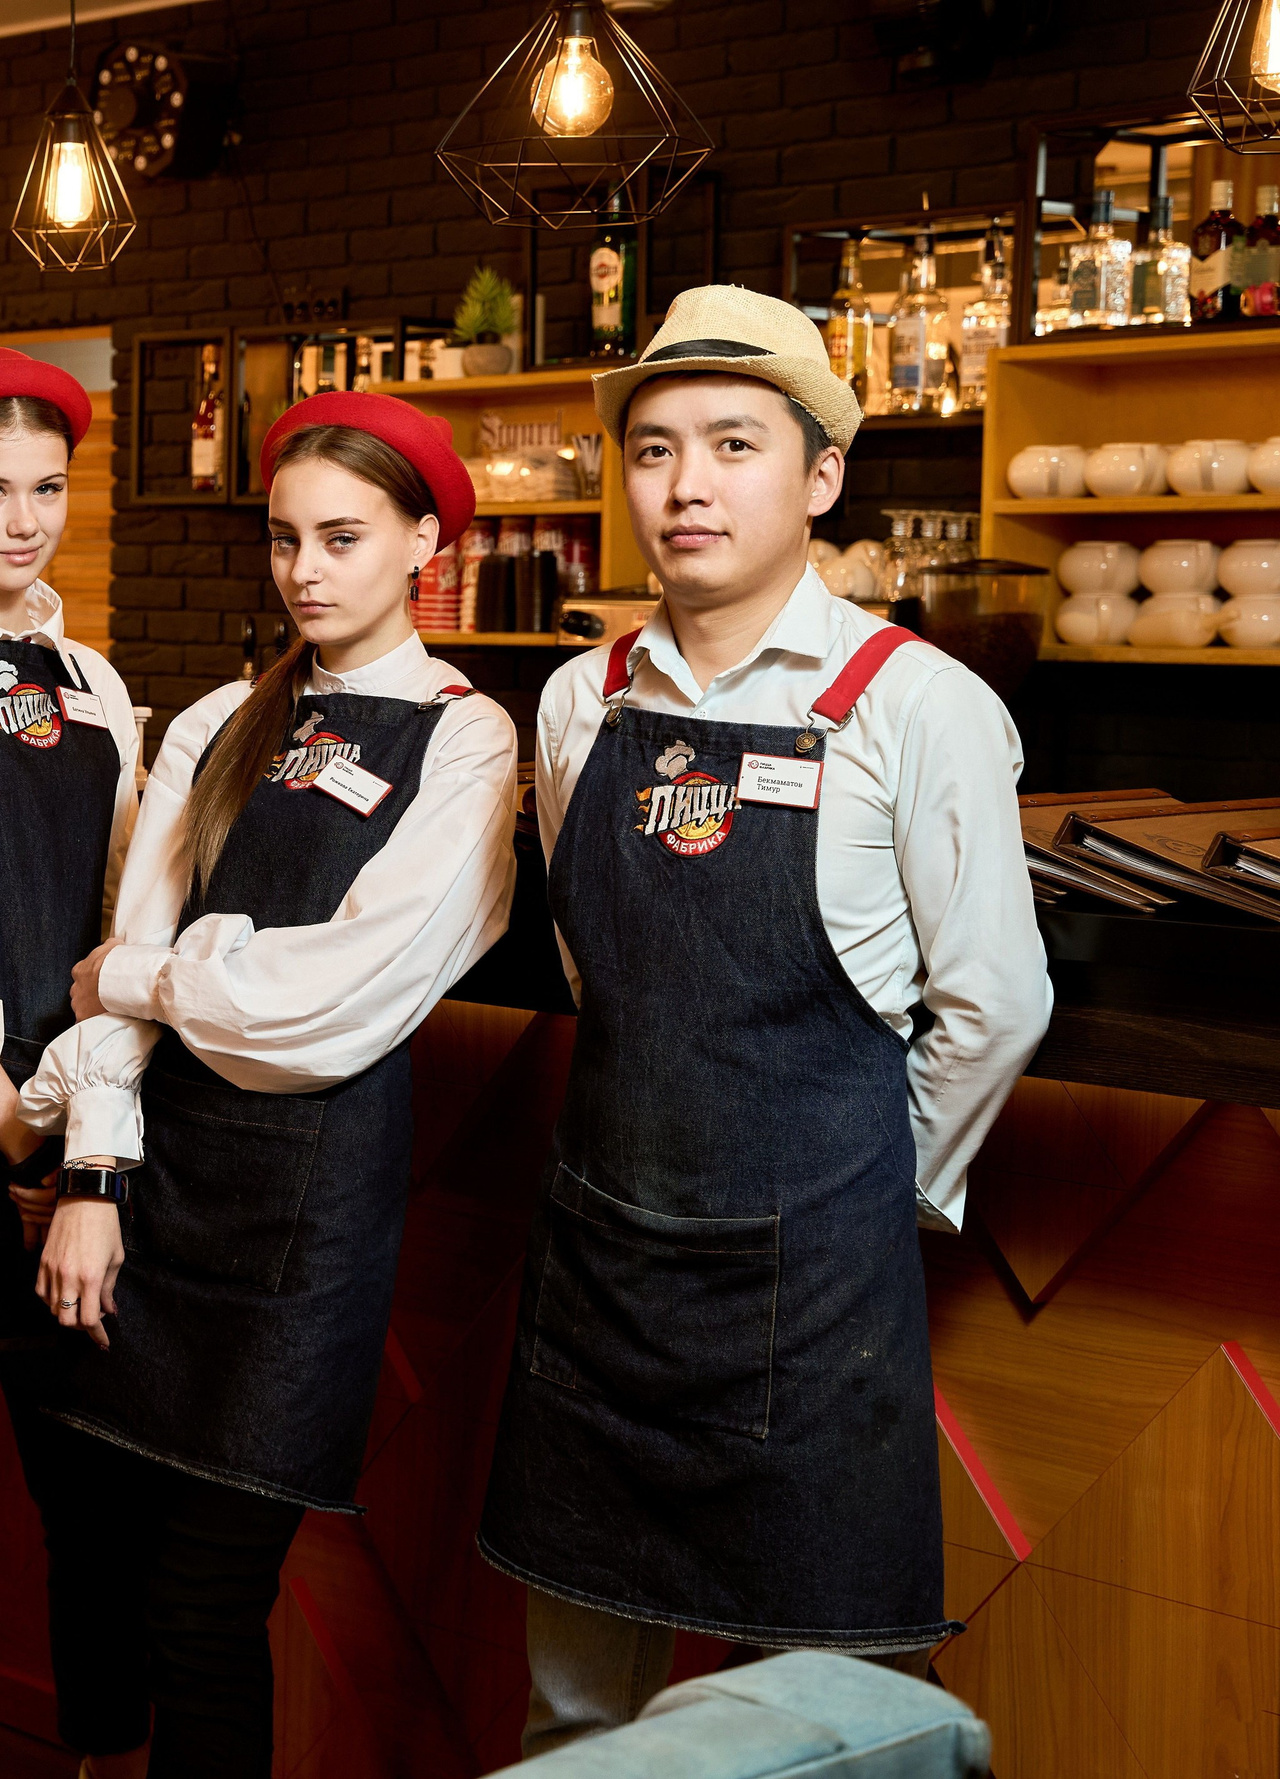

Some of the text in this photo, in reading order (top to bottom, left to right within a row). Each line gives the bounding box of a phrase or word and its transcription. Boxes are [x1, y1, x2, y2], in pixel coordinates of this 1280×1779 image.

[20, 729, 61, 747] ФАБРИКА
[757, 784, 781, 794] Тимур
[666, 830, 726, 854] ФАБРИКА
